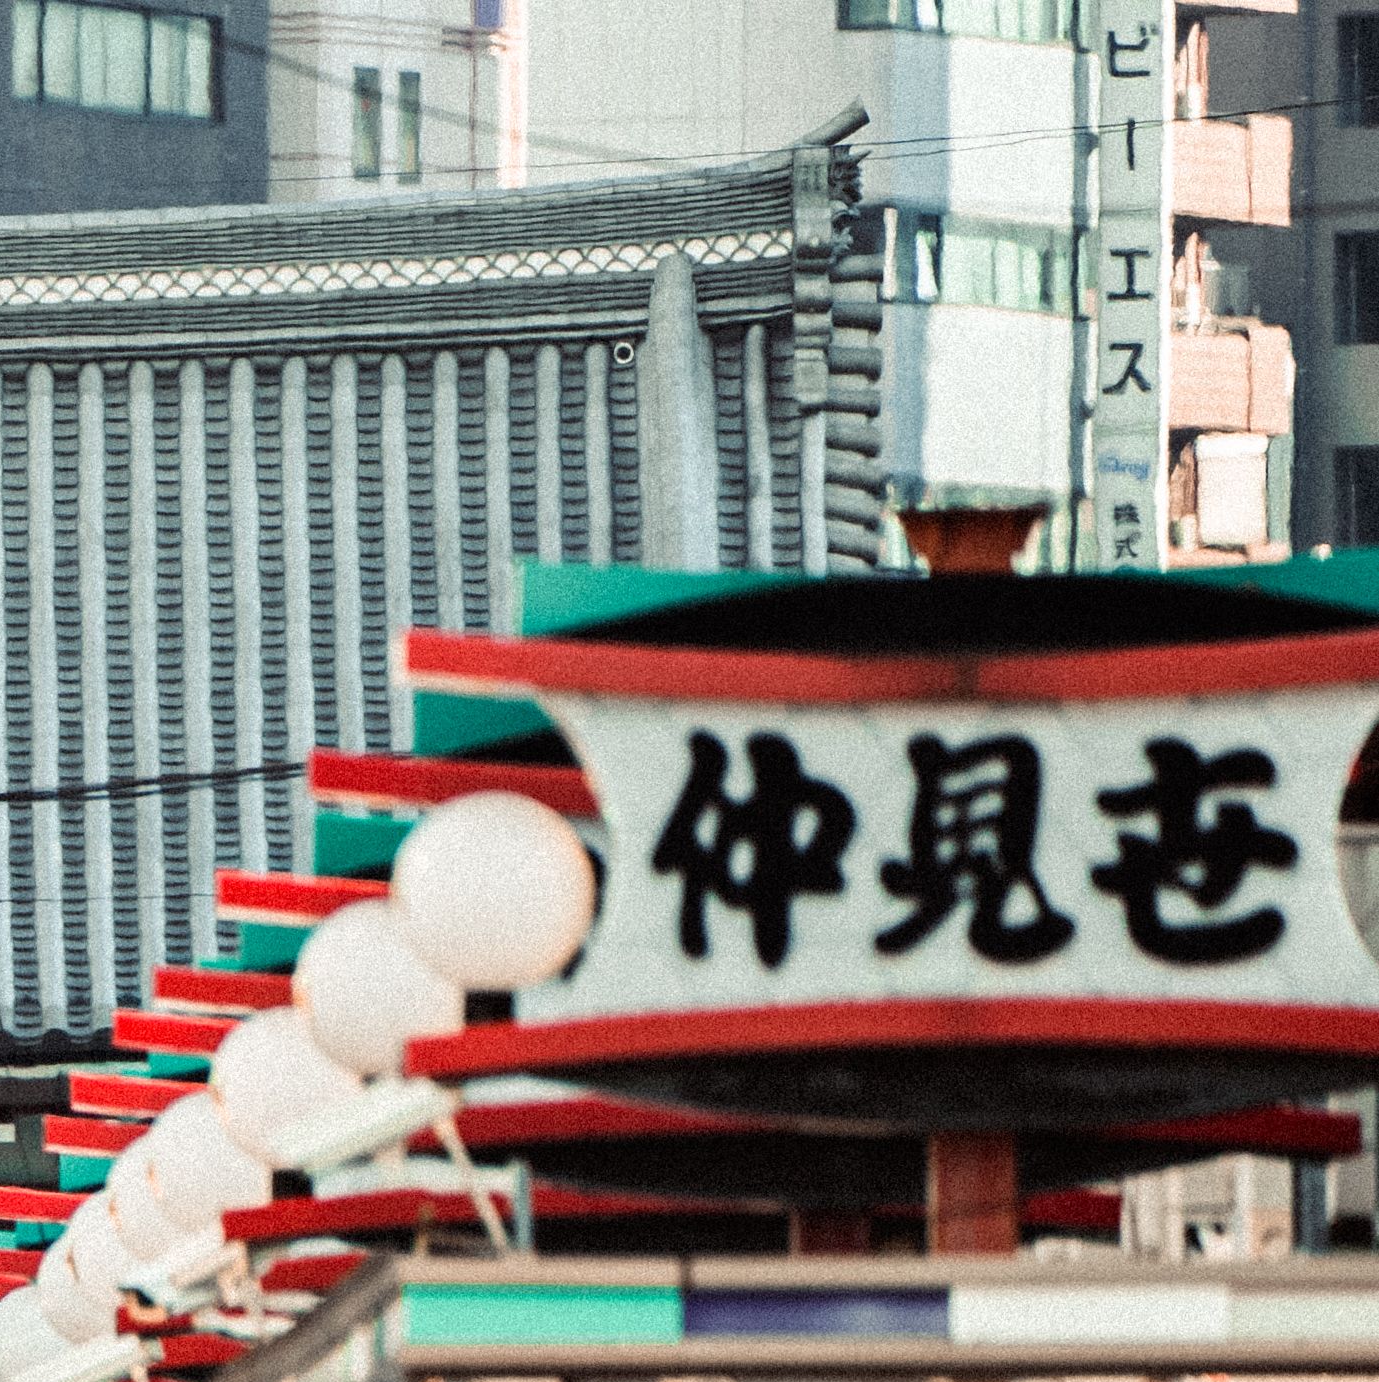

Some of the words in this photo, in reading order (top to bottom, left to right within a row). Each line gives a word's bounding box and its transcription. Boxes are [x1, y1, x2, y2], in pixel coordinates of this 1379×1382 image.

[1102, 20, 1159, 394] ビーエス
[650, 726, 1300, 970] 仲見世
